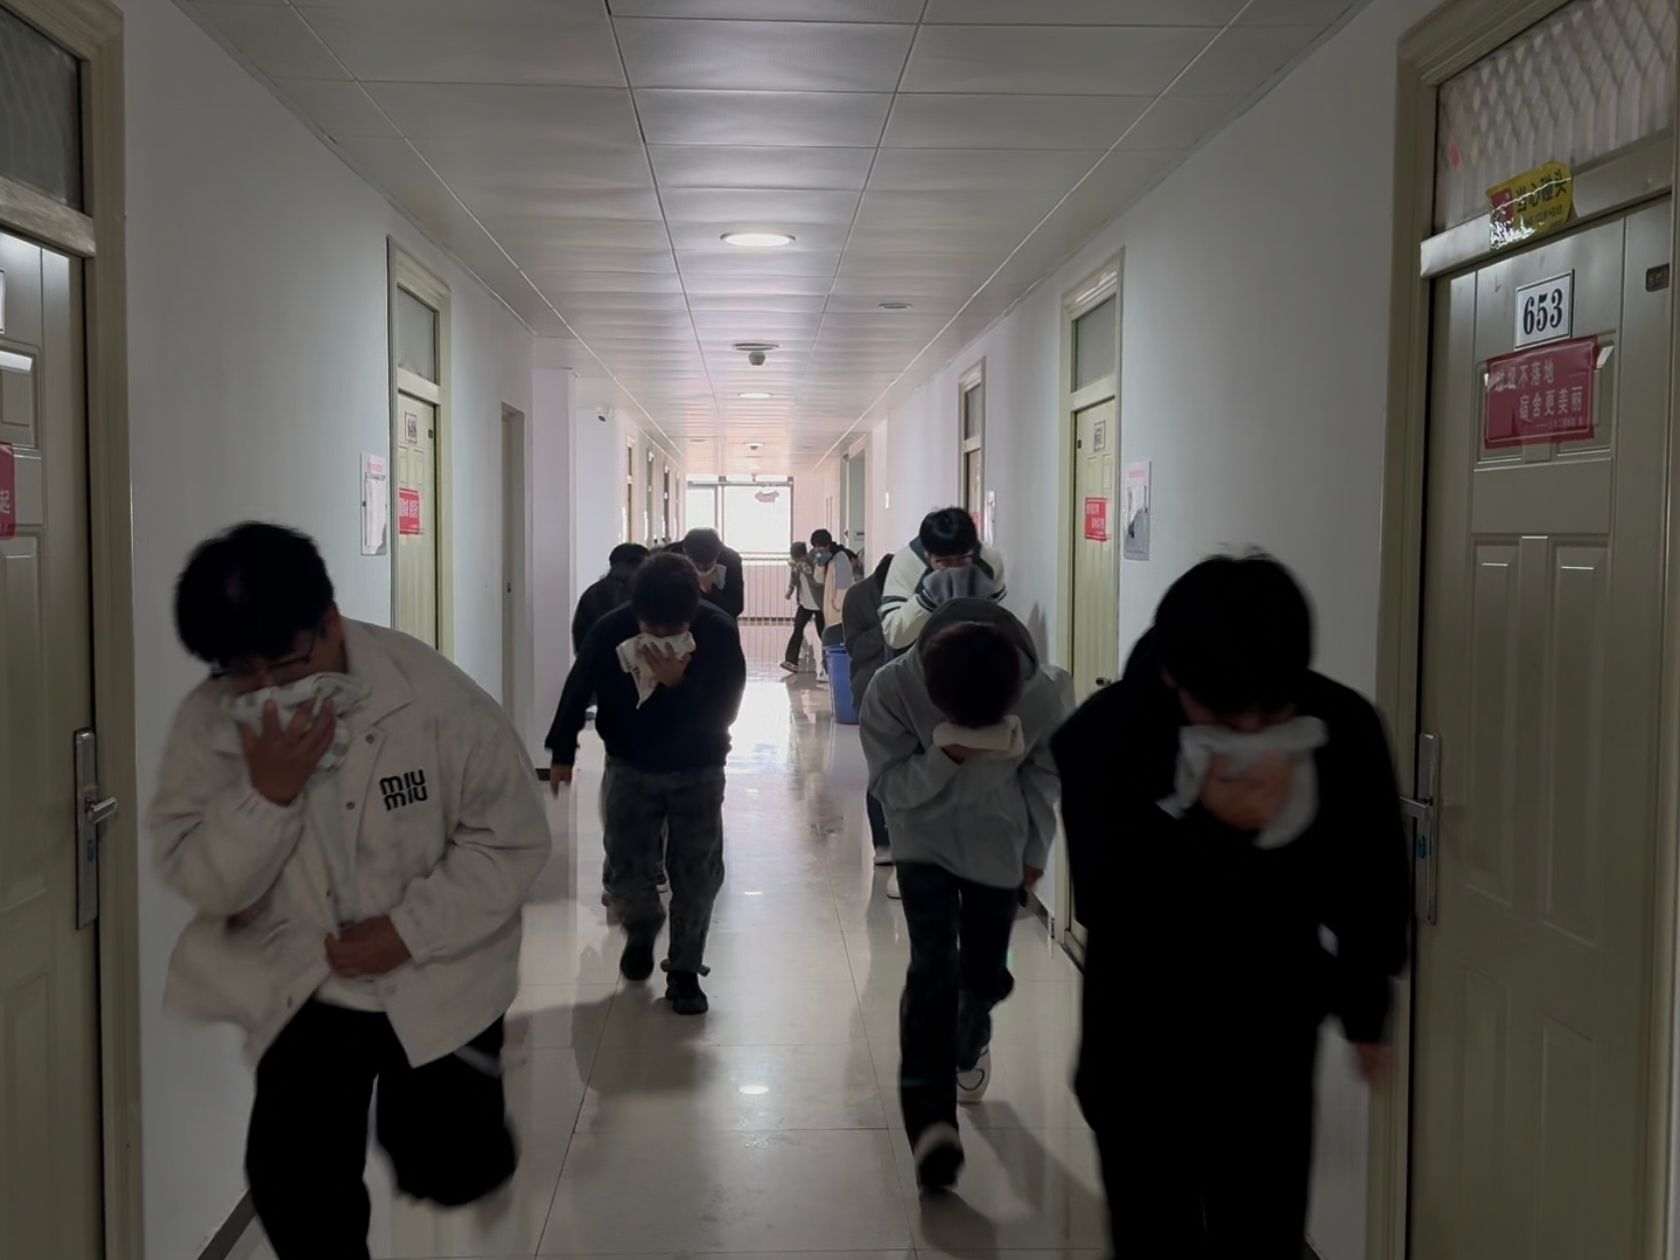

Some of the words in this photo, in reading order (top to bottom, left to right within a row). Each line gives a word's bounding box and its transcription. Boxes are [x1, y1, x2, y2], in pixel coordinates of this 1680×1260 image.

[1523, 289, 1563, 335] 653
[1519, 386, 1583, 423] 宿舍更美丽
